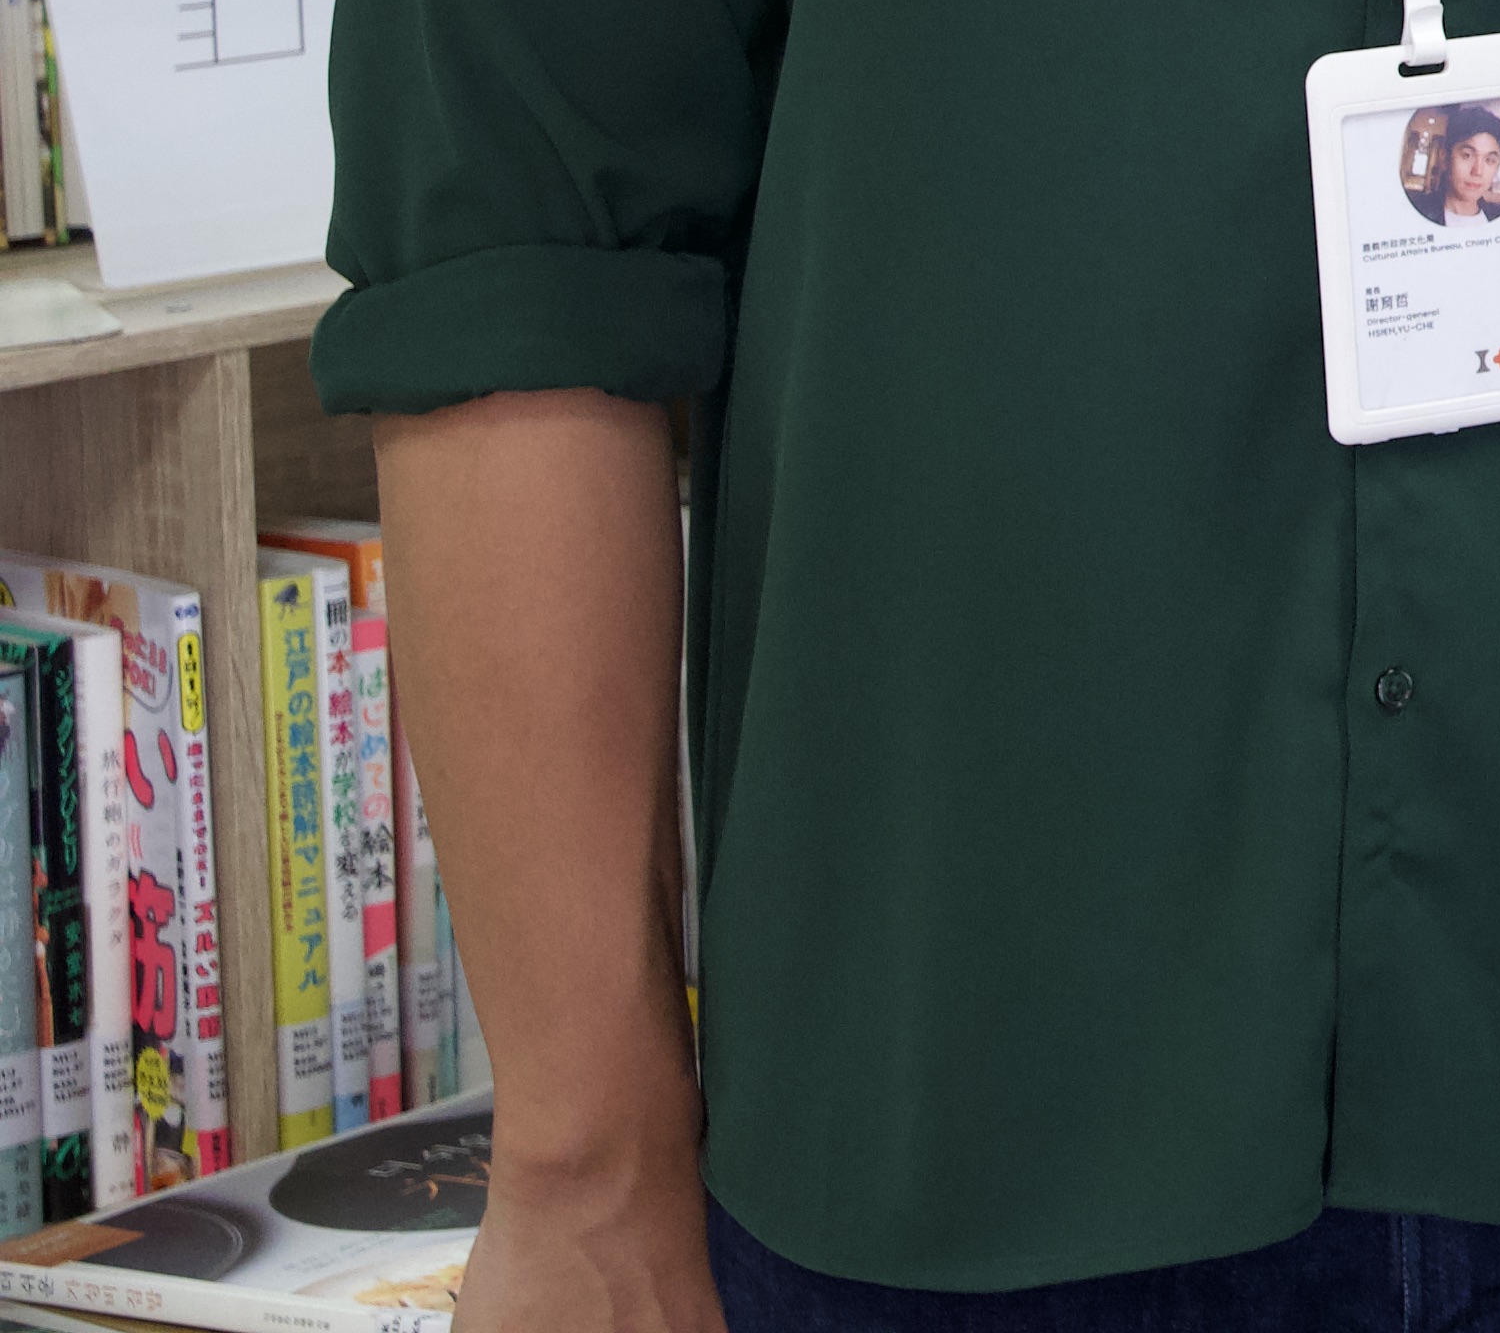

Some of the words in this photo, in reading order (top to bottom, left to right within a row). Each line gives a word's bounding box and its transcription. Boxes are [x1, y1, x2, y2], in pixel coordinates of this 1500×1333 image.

[1362, 248, 1399, 263] Cultural
[1400, 247, 1429, 258] Affairs
[1366, 308, 1440, 326] Director-general
[356, 666, 394, 890] はじめての絵本
